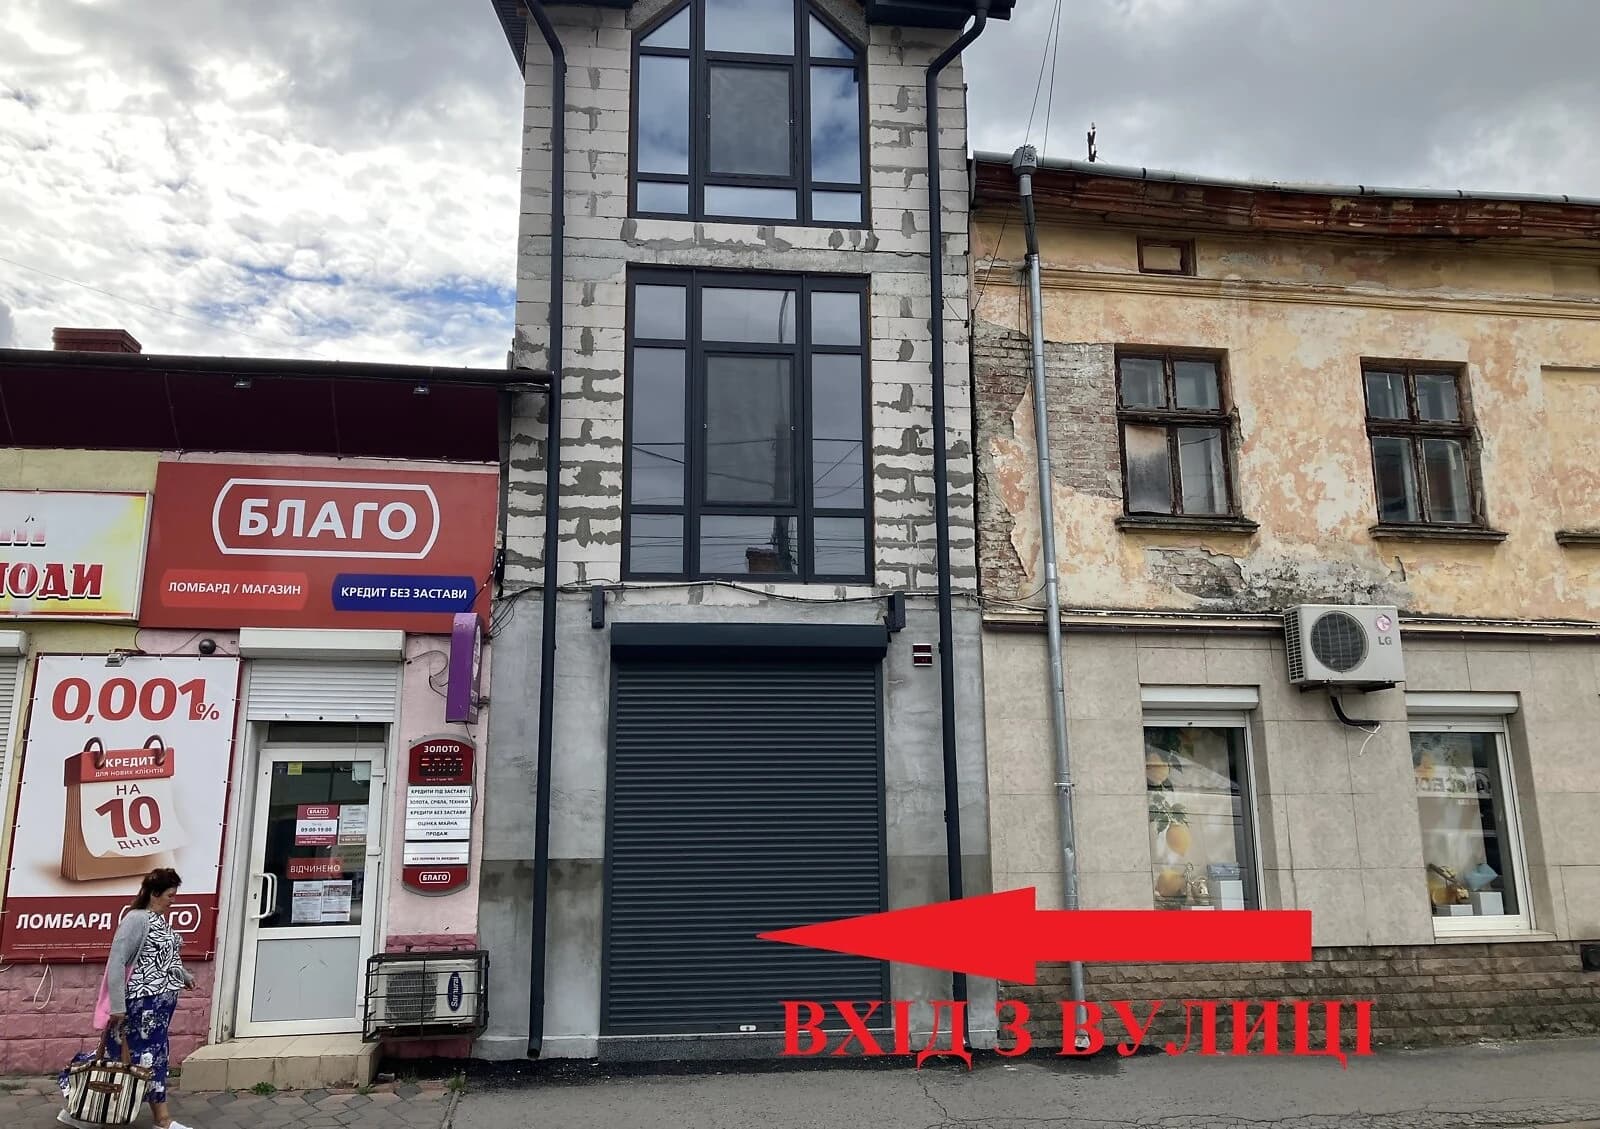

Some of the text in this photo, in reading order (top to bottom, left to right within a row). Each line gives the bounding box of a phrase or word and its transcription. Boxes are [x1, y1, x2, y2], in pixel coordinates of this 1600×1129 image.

[238, 498, 418, 541] БЛАГО
[168, 582, 230, 594] ЛОМБАРД
[241, 583, 301, 595] МАГАЗИН
[341, 587, 467, 599] КРЕДИТ БЕЗ ЗАСТАВИ
[1377, 636, 1393, 646] LG
[52, 677, 220, 724] 0,001%
[423, 745, 460, 753] ЗОЛОТО
[105, 756, 156, 768] КРЕДИТ
[110, 769, 133, 777] нових
[116, 784, 141, 796] НА
[95, 796, 162, 838] 10
[117, 837, 161, 850] ДНІВ
[290, 864, 341, 874] ВІДЧИНЕНО
[16, 912, 112, 929] ЛОМБАРД
